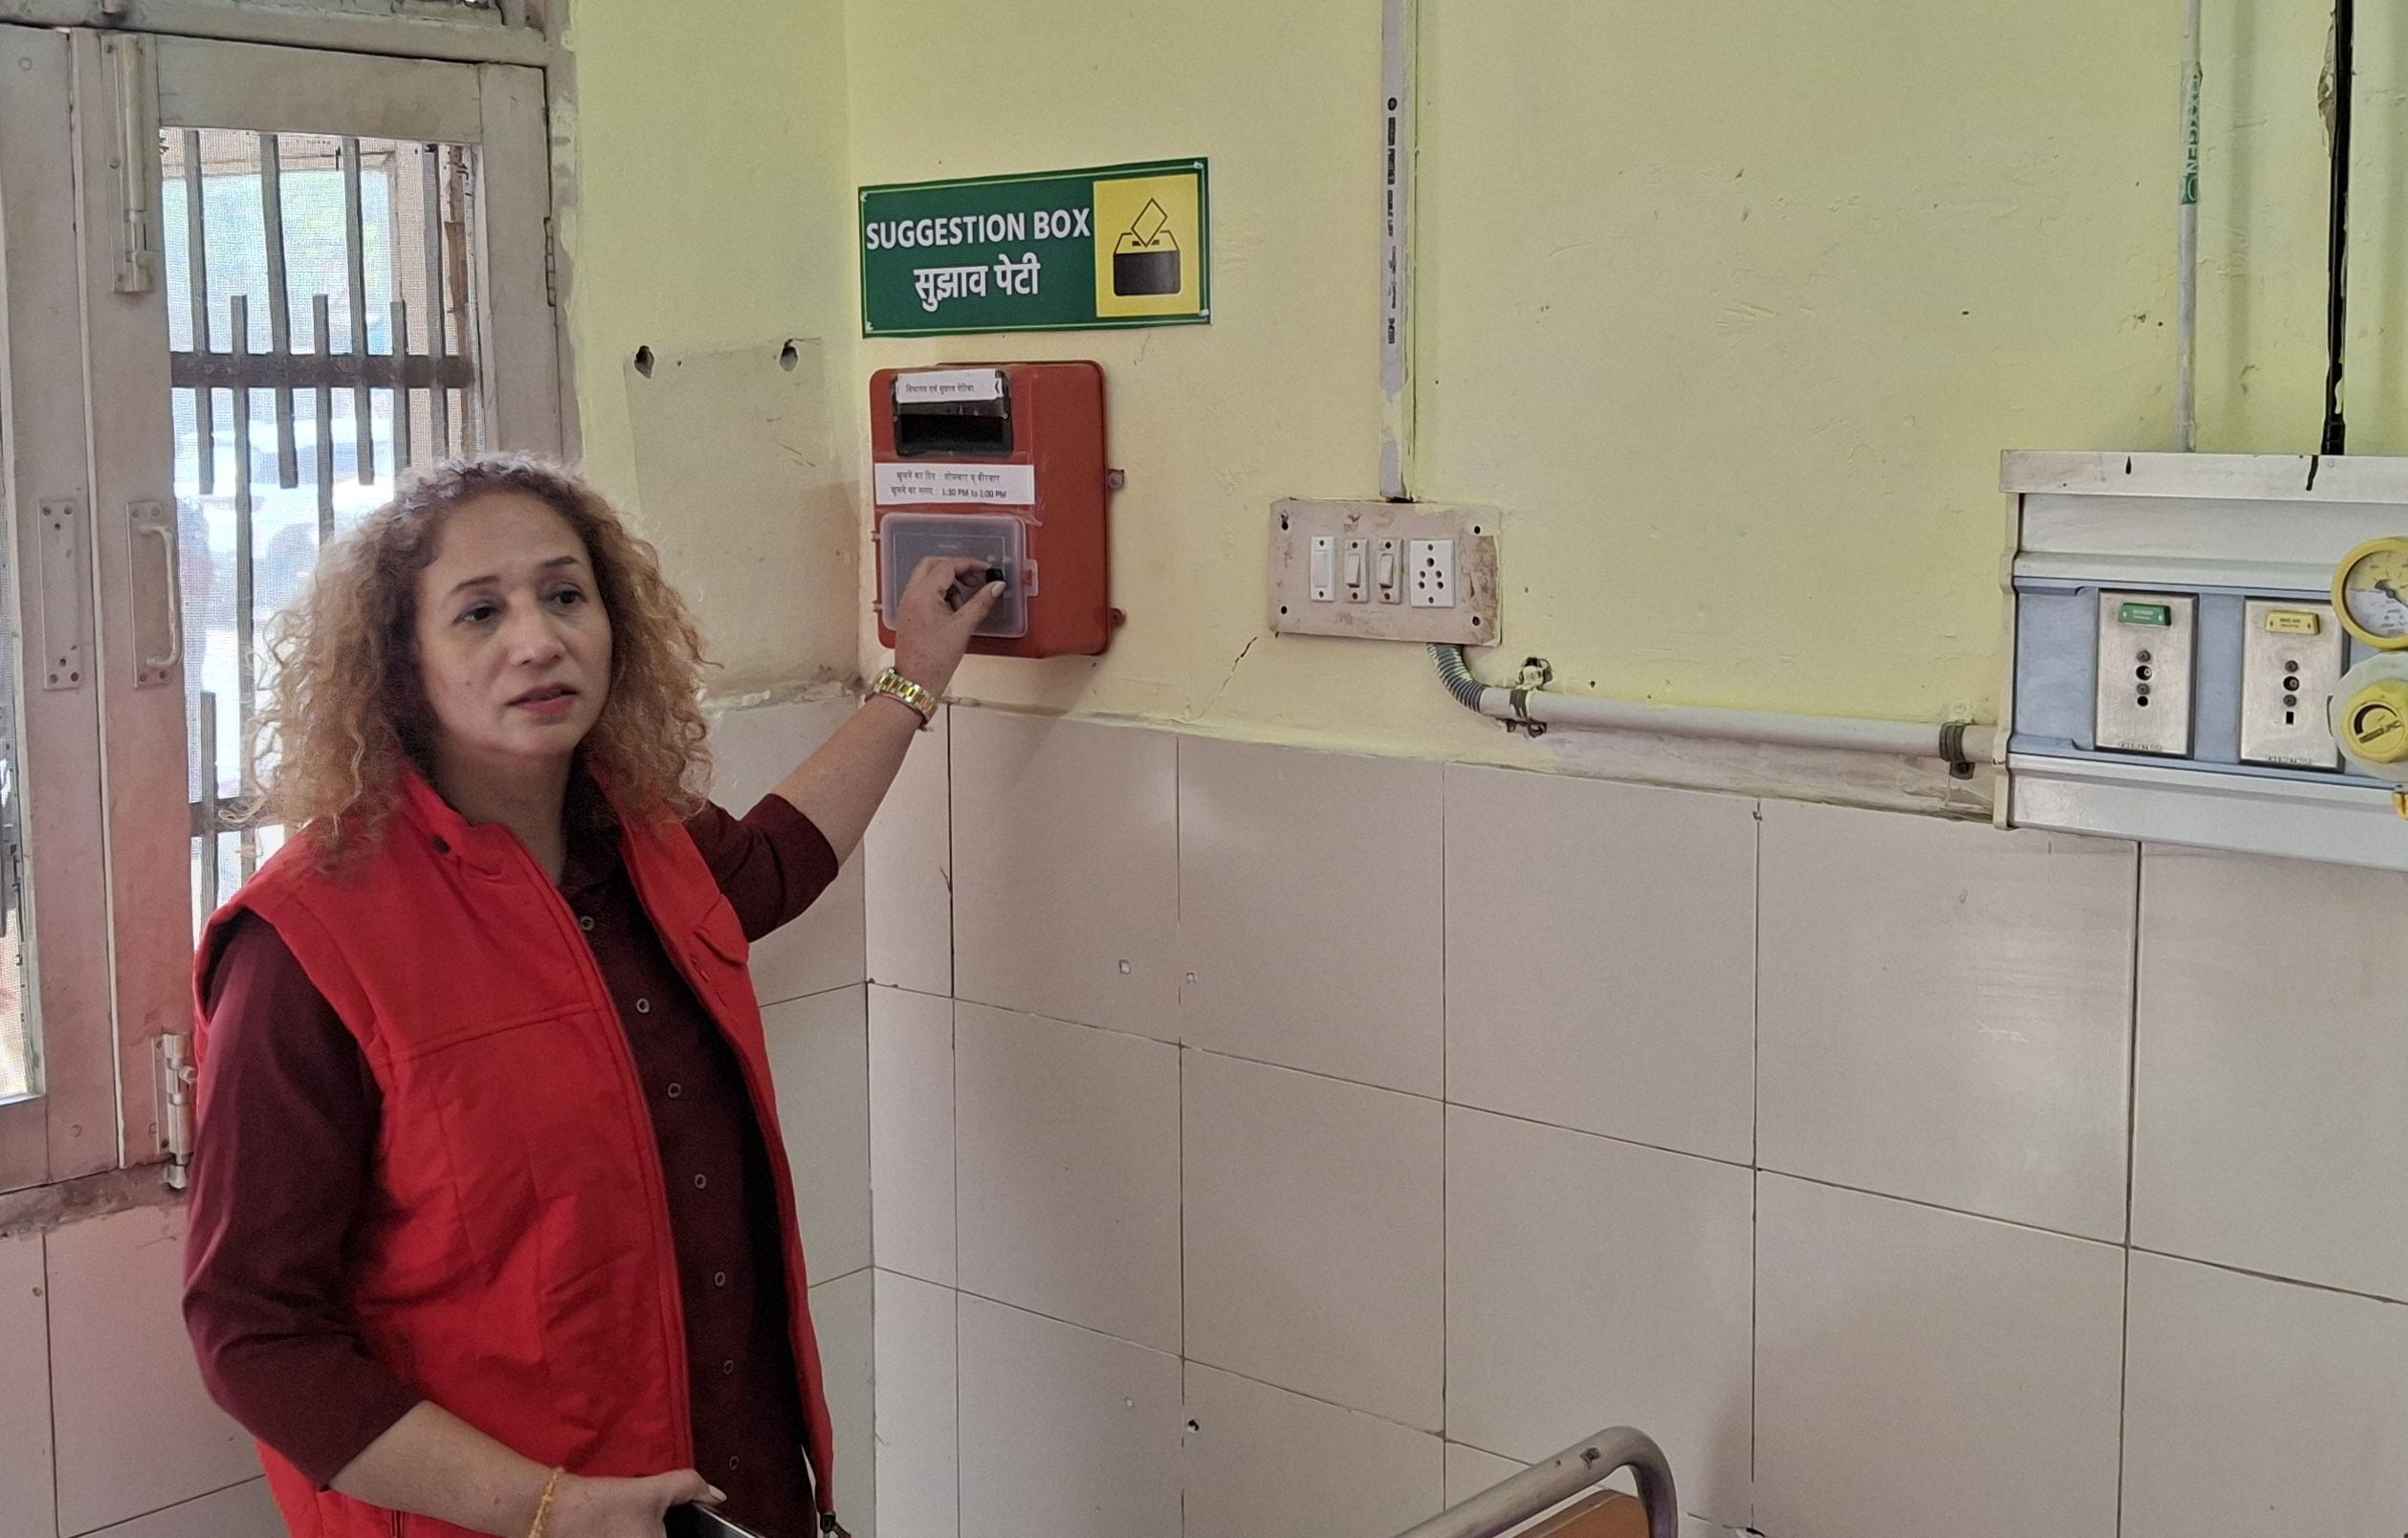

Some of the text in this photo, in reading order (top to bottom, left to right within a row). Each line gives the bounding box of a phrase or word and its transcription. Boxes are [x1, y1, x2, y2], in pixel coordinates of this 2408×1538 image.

[866, 208, 1091, 250] SUGGESTION BOX
[913, 252, 1041, 313] सुझाव पेटी
[958, 488, 969, 497] PM
[995, 490, 1007, 498] PM
